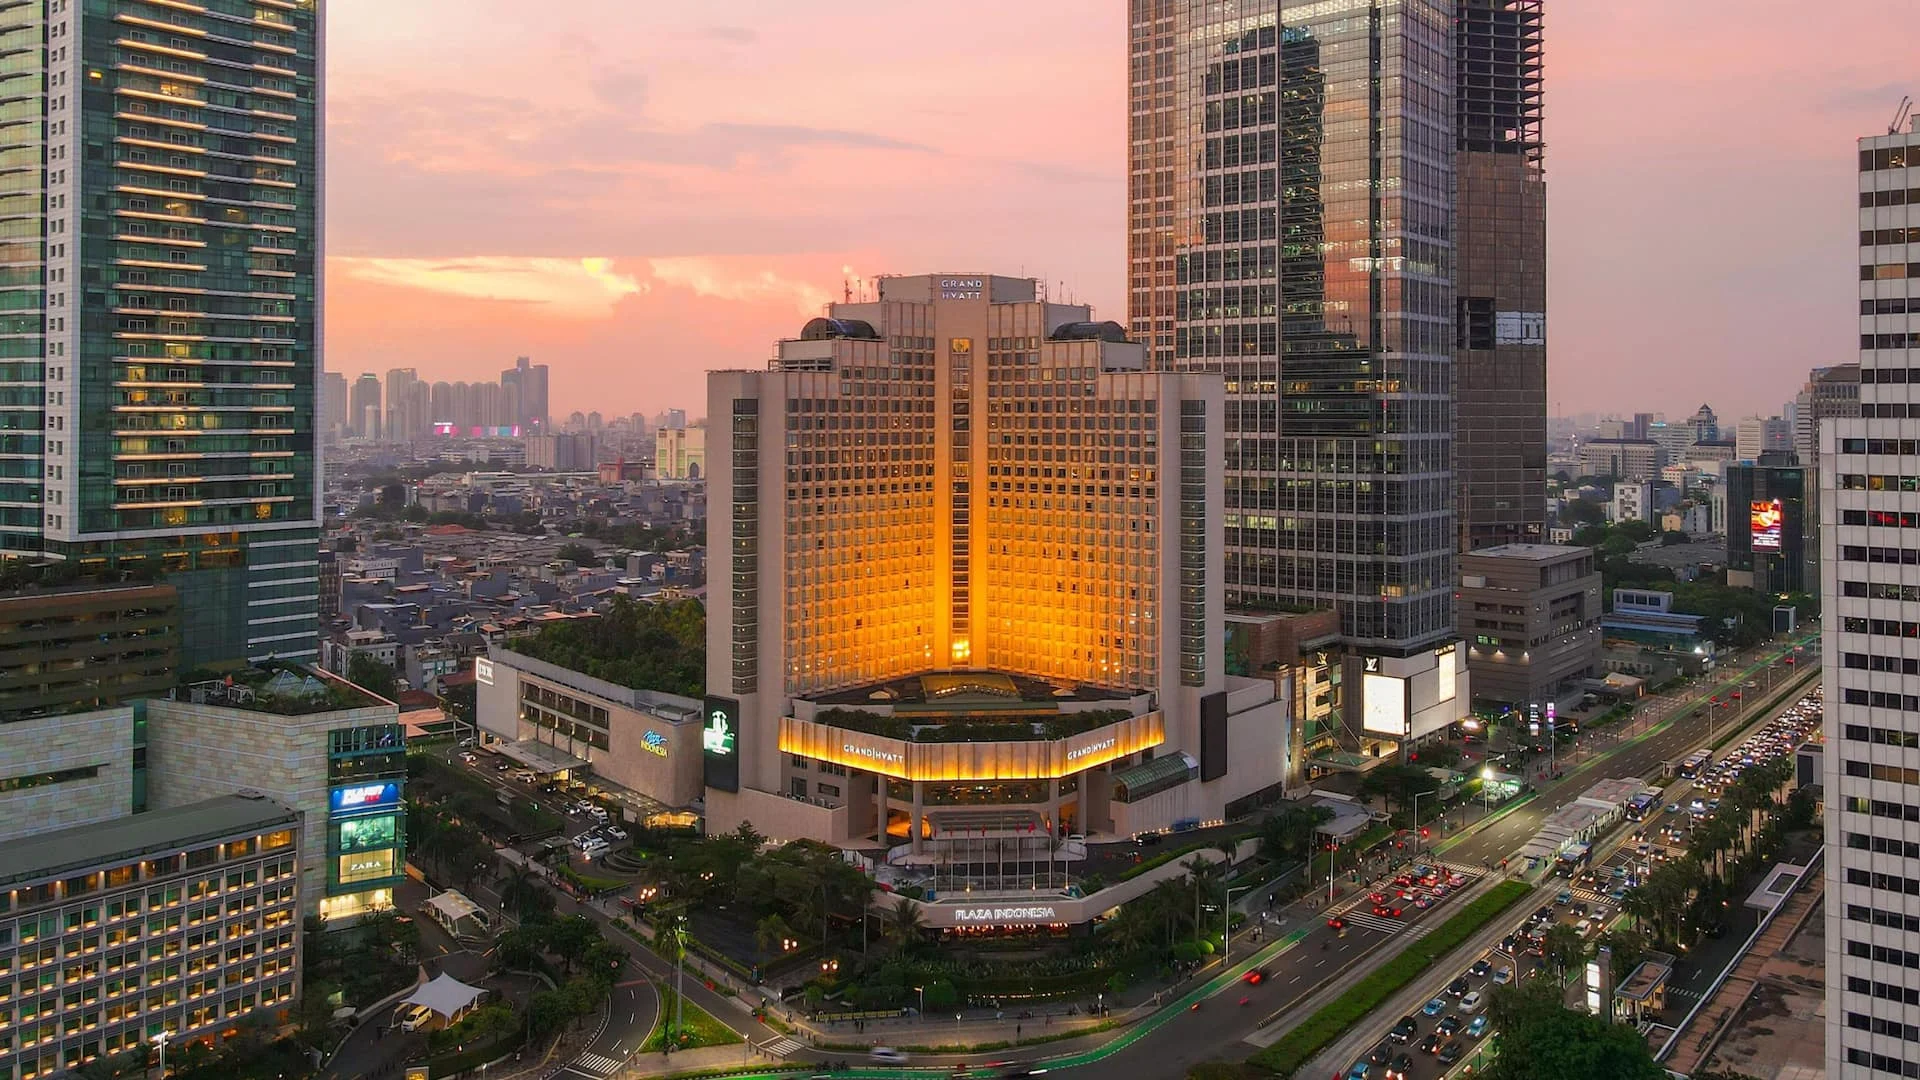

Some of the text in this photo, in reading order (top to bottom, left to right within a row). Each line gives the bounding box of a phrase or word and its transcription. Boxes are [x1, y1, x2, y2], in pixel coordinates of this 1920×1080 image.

[941, 279, 983, 288] GRAND
[942, 291, 981, 300] HYATT
[843, 744, 904, 764] GRAND HYATT
[1067, 738, 1115, 760] GRAND HYATT
[350, 860, 382, 871] ZARA
[955, 907, 1056, 921] PLAZA INDONESIA
